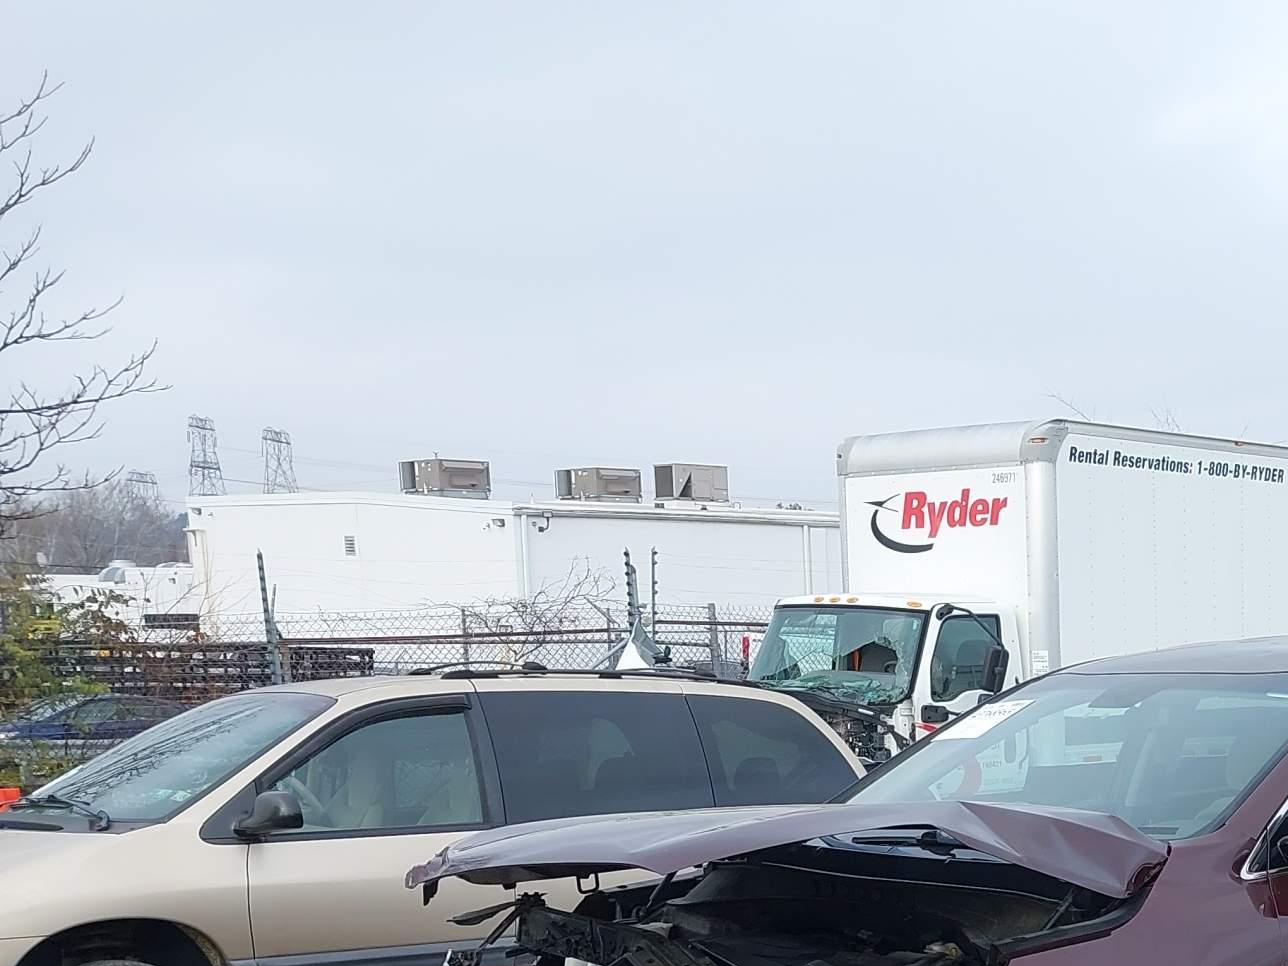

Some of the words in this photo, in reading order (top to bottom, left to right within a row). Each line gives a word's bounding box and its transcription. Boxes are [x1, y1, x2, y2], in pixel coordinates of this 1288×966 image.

[992, 472, 1016, 484] 246971
[1069, 446, 1109, 465] Rental
[1113, 450, 1192, 474] Reservations:
[1197, 460, 1285, 483] 1-800-BY-RYDER
[901, 488, 1008, 538] Ryder
